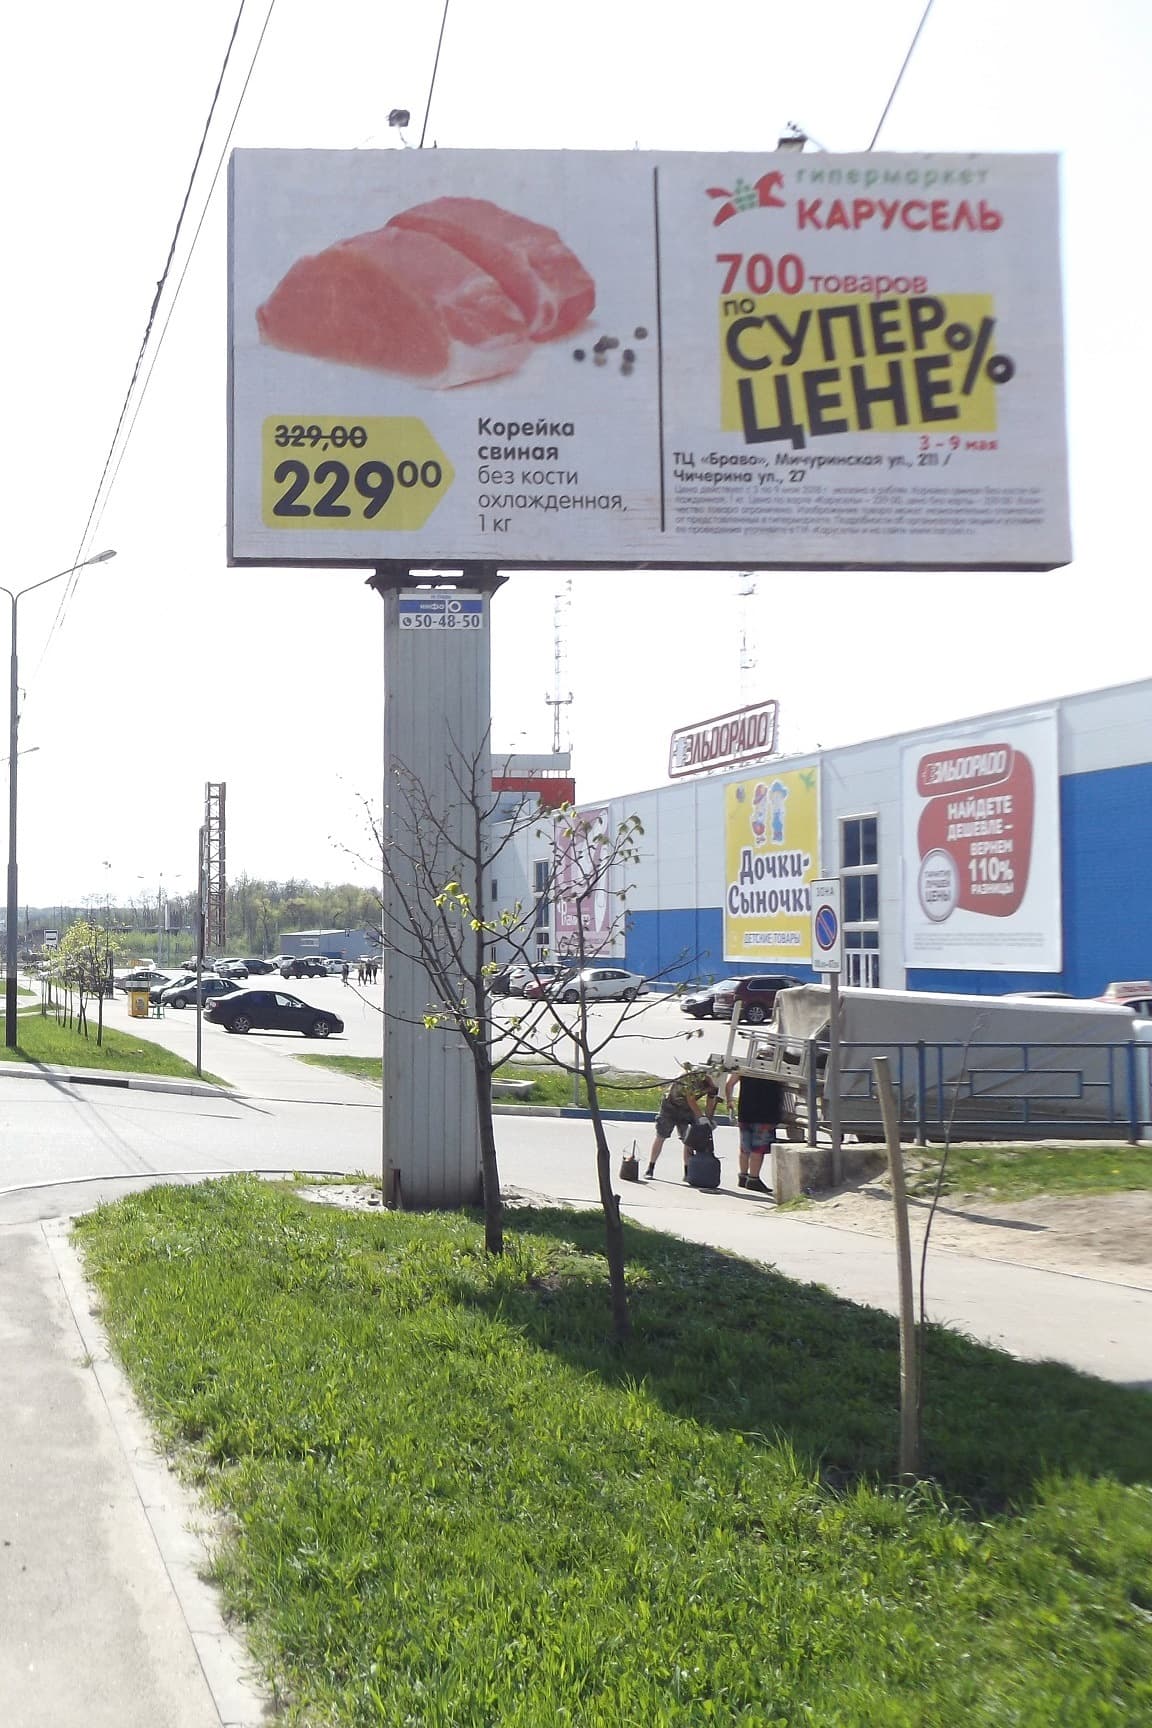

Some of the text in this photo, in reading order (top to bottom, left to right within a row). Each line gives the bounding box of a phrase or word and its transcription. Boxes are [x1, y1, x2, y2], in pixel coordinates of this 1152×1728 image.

[796, 167, 990, 187] гипермаркет
[796, 198, 1003, 232] КАРУСЕЛЬ
[716, 254, 928, 298] 700 товаров
[723, 299, 755, 316] по
[726, 296, 946, 371] СУПЕР
[737, 354, 960, 450] ЦЕНЕ
[478, 417, 575, 438] Корейка
[275, 425, 367, 451] 329,00
[966, 439, 998, 450] мая
[478, 445, 559, 461] свиная
[673, 452, 694, 468] ТЦ
[775, 453, 883, 469] Мичуринская
[478, 467, 579, 485] без кости
[673, 470, 752, 486] Чичерина
[789, 470, 806, 482] 27
[478, 494, 628, 514] охлажденная,
[478, 515, 512, 532] 1 кг
[415, 614, 480, 628] 50-48-50
[948, 795, 1013, 820] НАЙДЕТЕ
[740, 850, 809, 885] Дочки-
[968, 857, 1014, 881] 110%
